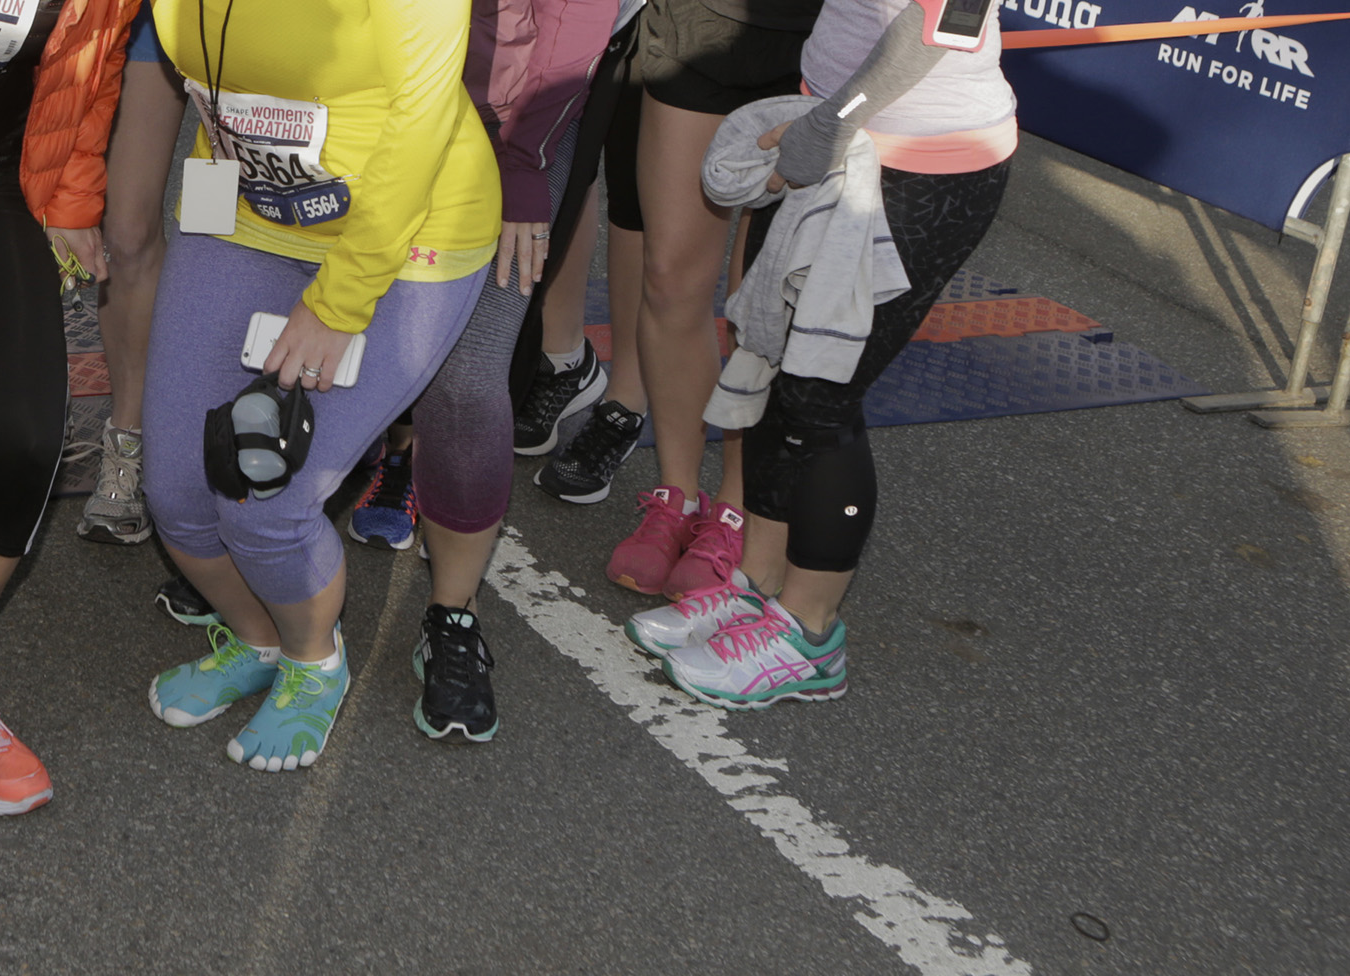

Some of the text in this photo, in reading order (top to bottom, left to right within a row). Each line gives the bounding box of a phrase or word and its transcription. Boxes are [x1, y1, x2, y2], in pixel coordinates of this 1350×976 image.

[1157, 43, 1312, 110] RUN FOR LIFE
[226, 107, 249, 115] SHAPE
[232, 117, 314, 141] MARATHON
[257, 204, 282, 220] 5564
[302, 193, 340, 219] 5564
